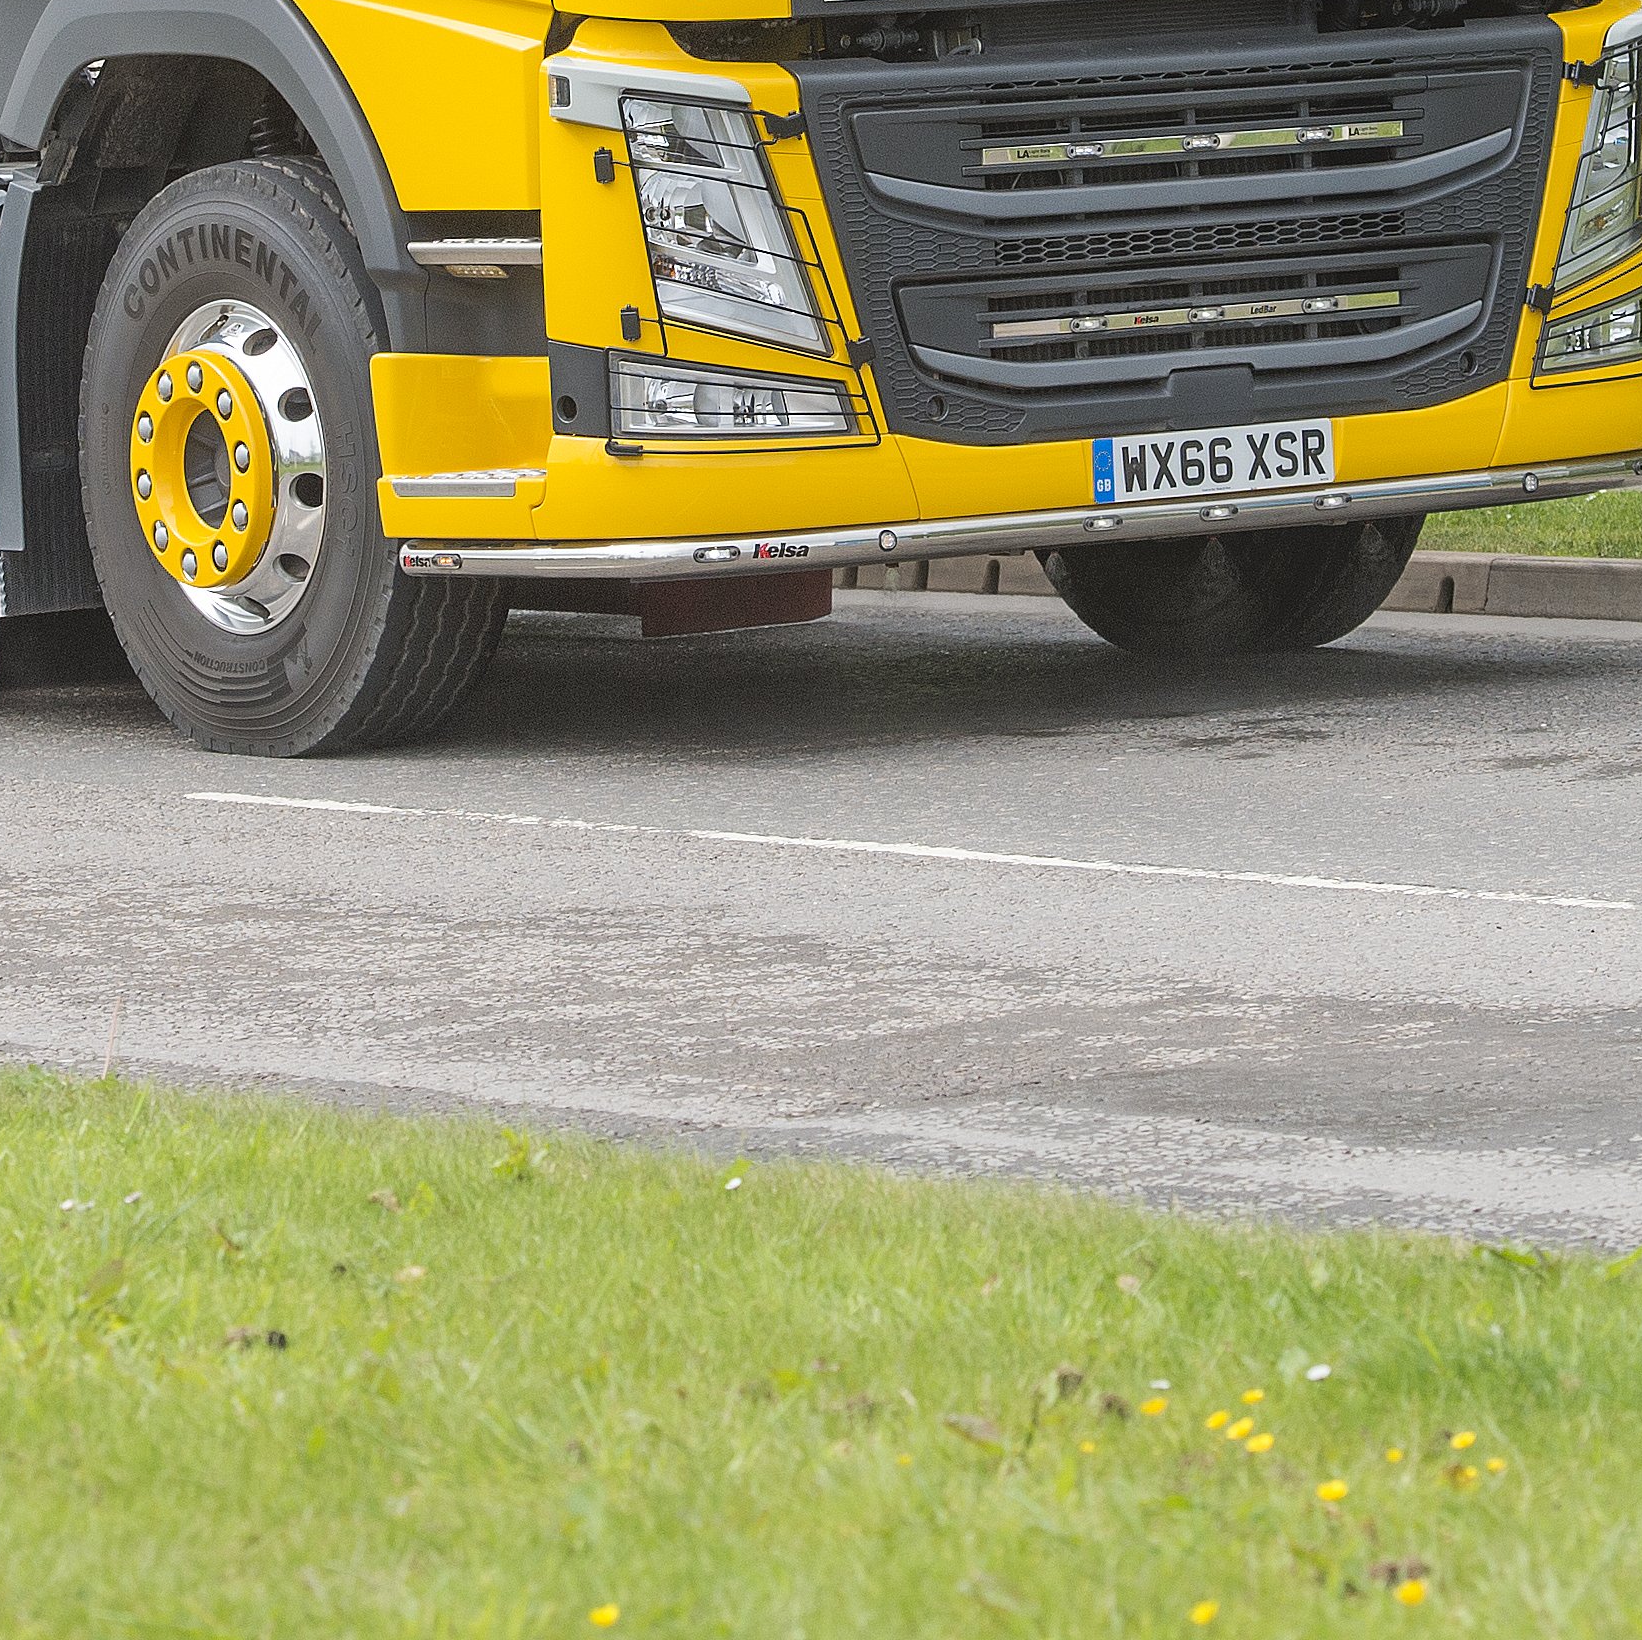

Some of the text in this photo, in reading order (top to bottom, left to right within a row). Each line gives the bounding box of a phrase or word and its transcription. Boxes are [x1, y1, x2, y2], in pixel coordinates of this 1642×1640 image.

[123, 222, 323, 353] CONTINENTAL
[1121, 429, 1327, 493] WX66 XSR
[1096, 479, 1112, 492] GB
[752, 543, 810, 558] Kelsa
[403, 555, 431, 567] Kelsa
[193, 651, 267, 675] CONSTRUCTION
